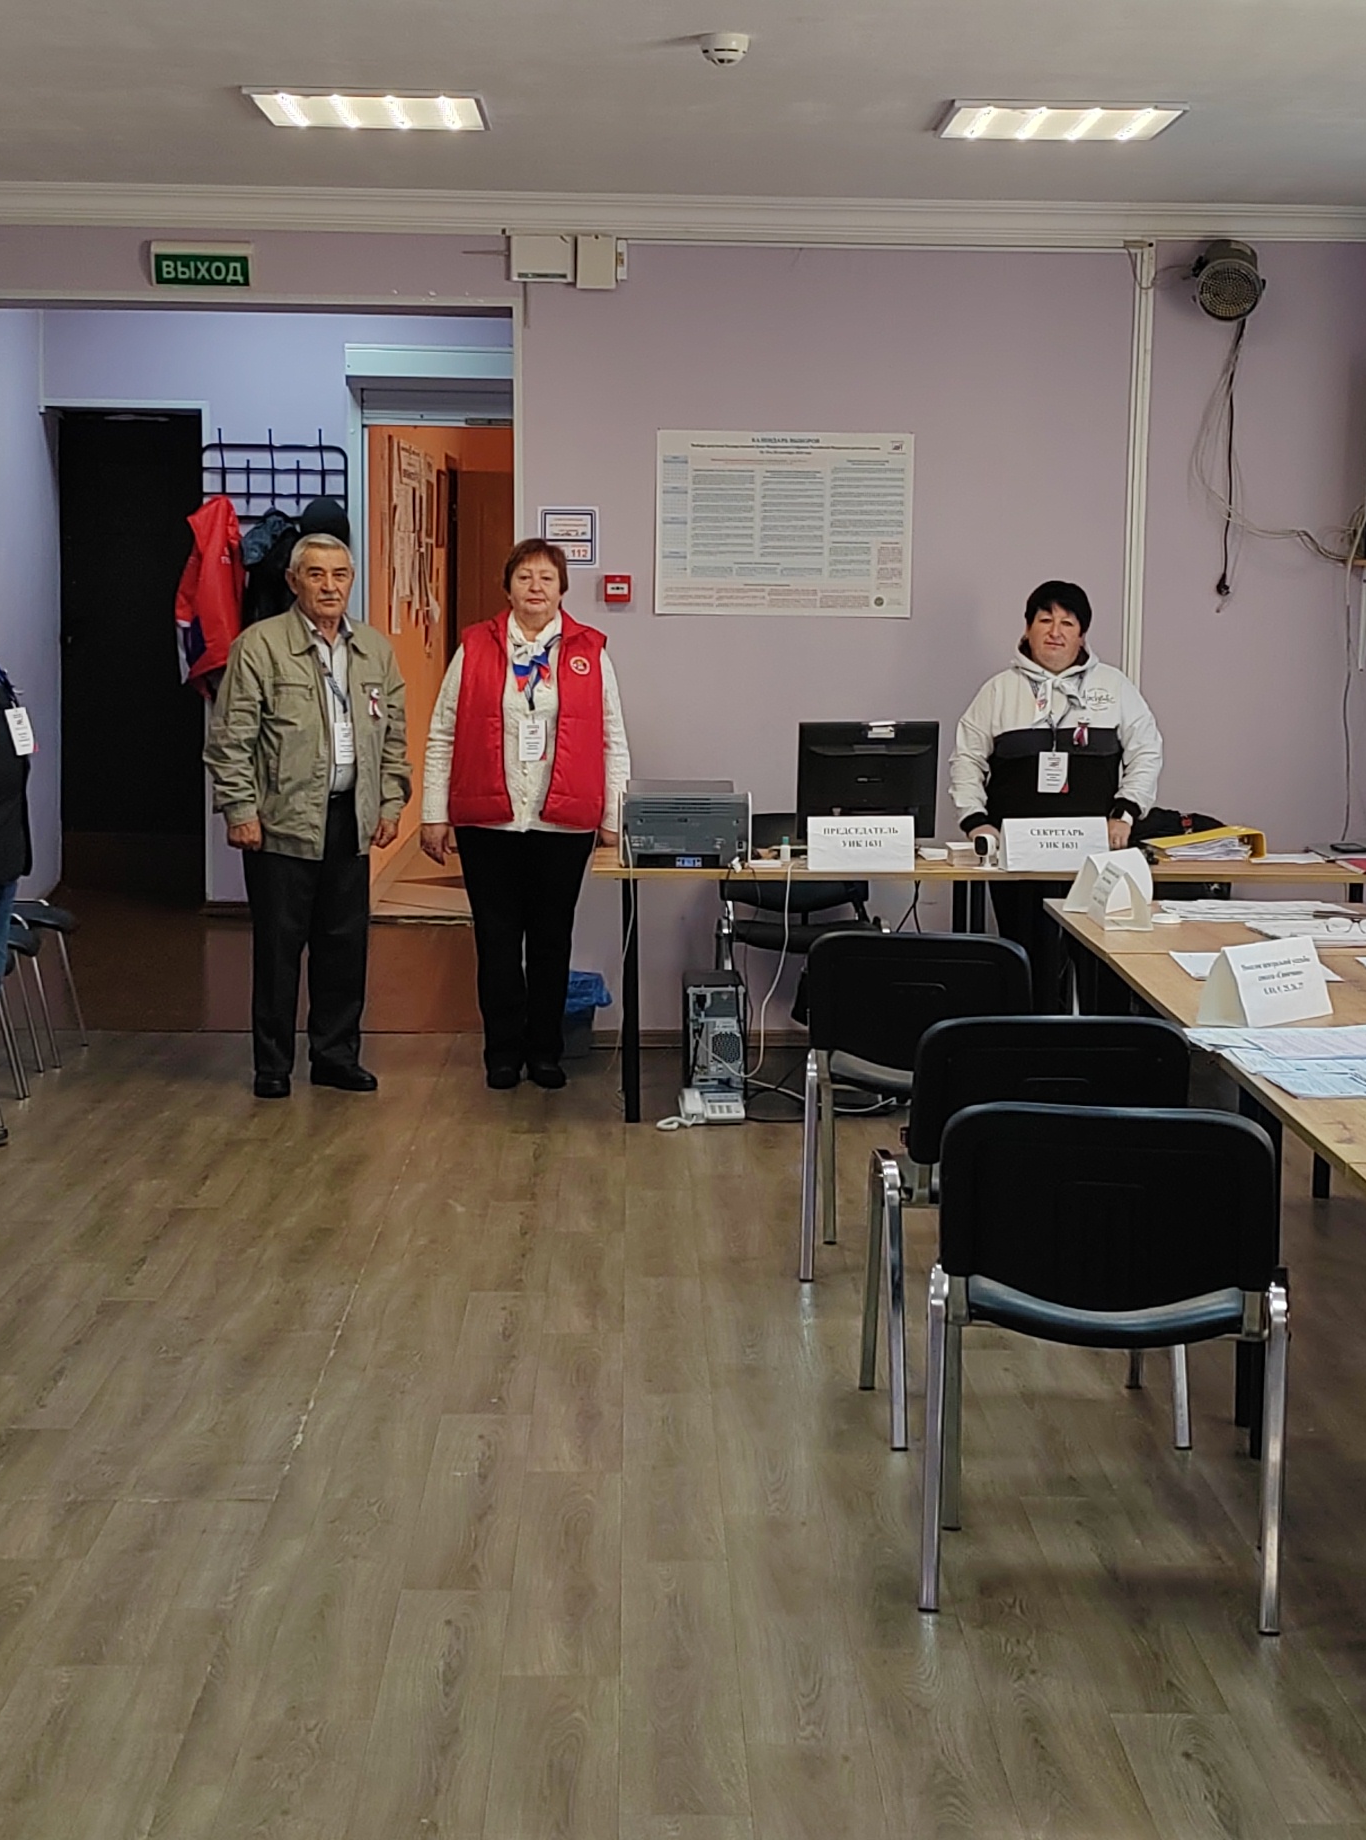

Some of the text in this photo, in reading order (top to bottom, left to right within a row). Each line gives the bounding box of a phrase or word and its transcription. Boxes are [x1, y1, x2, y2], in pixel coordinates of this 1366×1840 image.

[162, 261, 244, 283] ВЫХОД
[571, 549, 587, 557] 112
[823, 826, 899, 836] ПРЕДСЕДАТЕЛЬ
[1029, 828, 1085, 837] СЕКРЕТАРЬ
[841, 839, 883, 848] УИК 1631
[1039, 841, 1079, 850] УИК 1631
